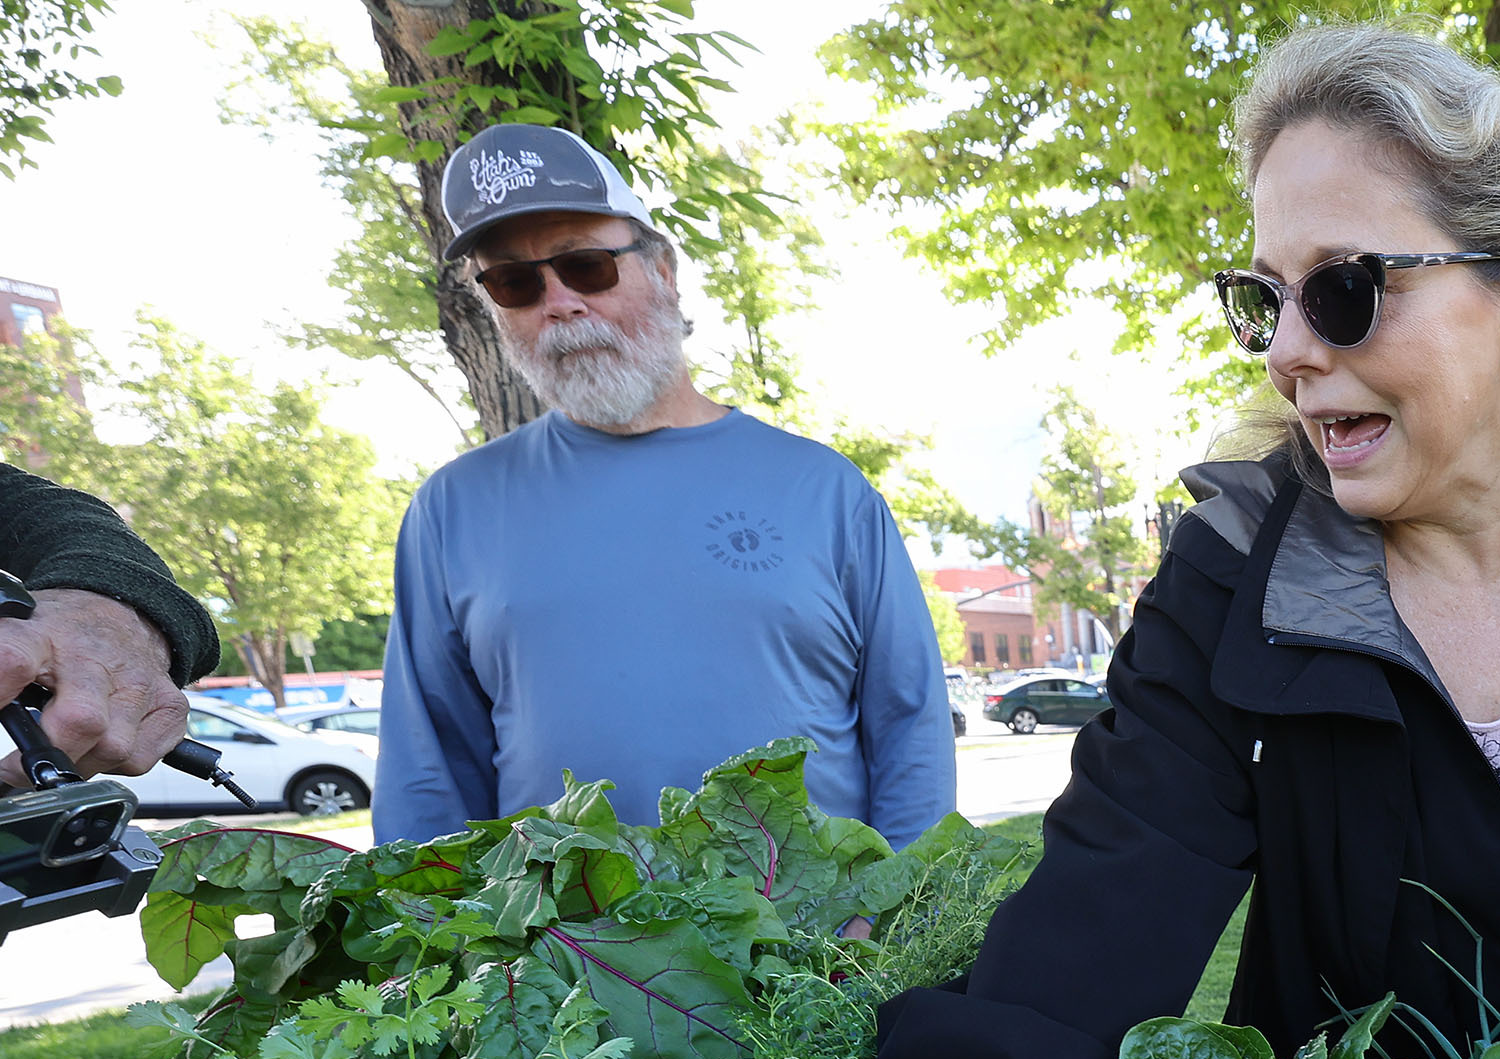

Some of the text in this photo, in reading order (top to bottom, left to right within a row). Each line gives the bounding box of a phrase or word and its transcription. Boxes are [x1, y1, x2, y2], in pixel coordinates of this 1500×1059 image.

[469, 149, 521, 191] Utah's
[488, 167, 537, 204] Own
[704, 511, 784, 541] HANG TEN
[705, 544, 784, 572] ORIGINALS
